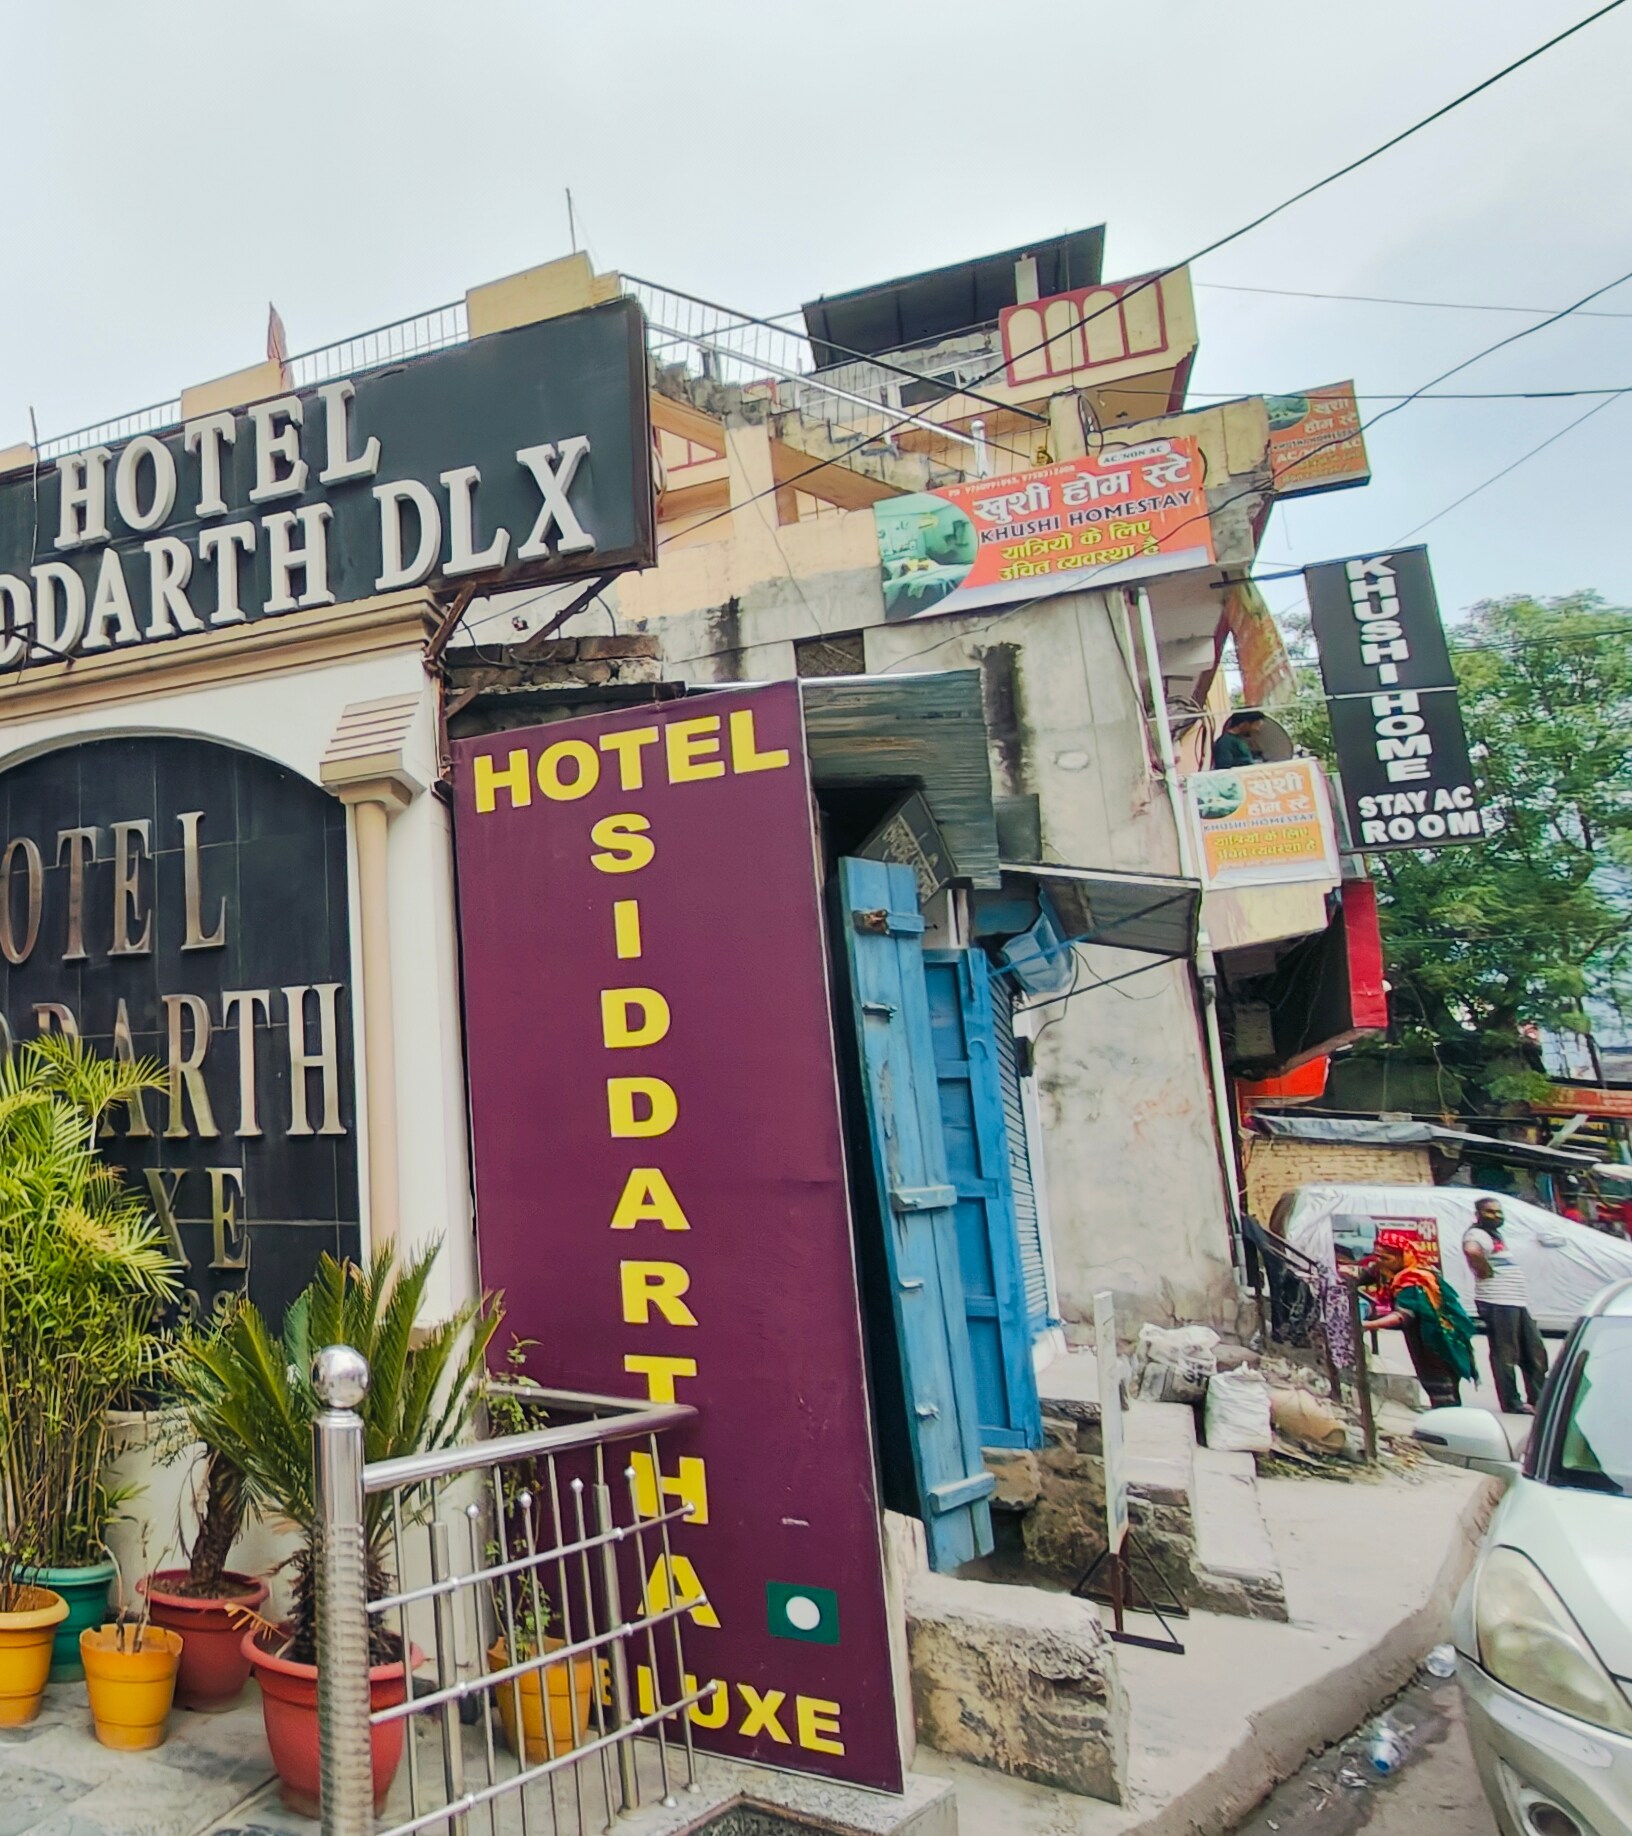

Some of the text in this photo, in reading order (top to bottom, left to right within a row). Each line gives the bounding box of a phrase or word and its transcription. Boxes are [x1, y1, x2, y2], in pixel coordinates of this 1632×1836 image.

[54, 380, 380, 550] HOTEL
[972, 483, 1051, 525] खुशी
[1062, 470, 1132, 506] होम
[1141, 453, 1192, 489] स्टे
[373, 435, 596, 592] DLX
[980, 491, 1193, 544] KHUSHI HOMESTAY
[1109, 520, 1151, 541] लिए
[1345, 555, 1409, 685] KHUSHI
[473, 709, 790, 813] HOTEL
[1372, 692, 1432, 783] HOME
[1358, 786, 1474, 818] STAY AC
[1362, 810, 1481, 844] ROOM
[595, 1657, 845, 1756] ELUXE
